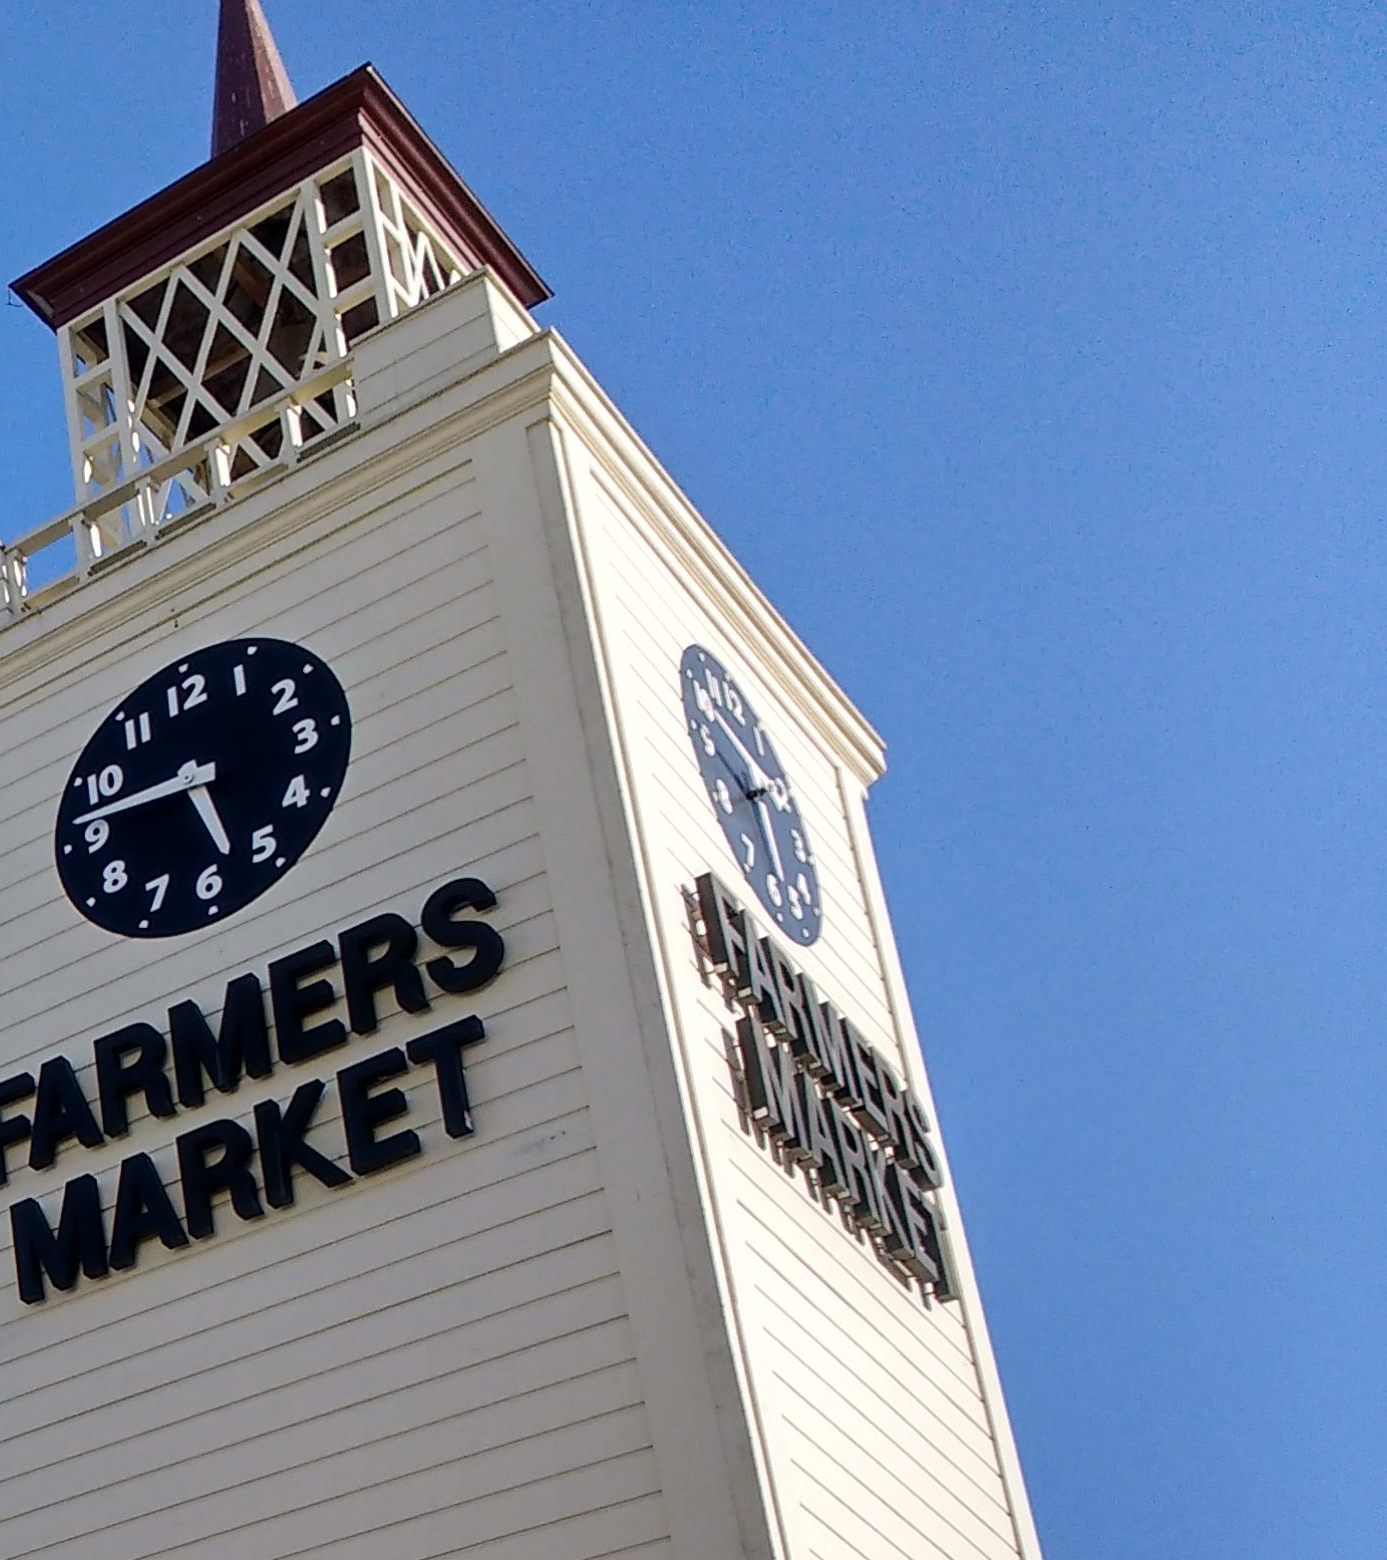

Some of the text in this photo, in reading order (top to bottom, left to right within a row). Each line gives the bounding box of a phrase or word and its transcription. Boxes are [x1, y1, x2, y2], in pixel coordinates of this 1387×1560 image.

[167, 673, 208, 718] 12
[233, 664, 247, 696] 1
[270, 678, 299, 716] 2
[705, 668, 722, 708] 11
[723, 681, 745, 726] 12
[124, 712, 151, 750] 11
[291, 718, 319, 754] 3
[753, 724, 765, 757] 1
[87, 764, 124, 805] 10
[281, 774, 310, 808] 4
[84, 819, 110, 854] 9
[251, 824, 276, 863] 5
[741, 833, 754, 874] 7
[791, 828, 807, 863] 3
[102, 859, 127, 893] 8
[144, 873, 170, 912] 7
[195, 864, 223, 901] 6
[694, 872, 944, 1192] FARMERS
[9, 1014, 485, 1304] MARKET
[736, 1014, 962, 1304] MARKET
